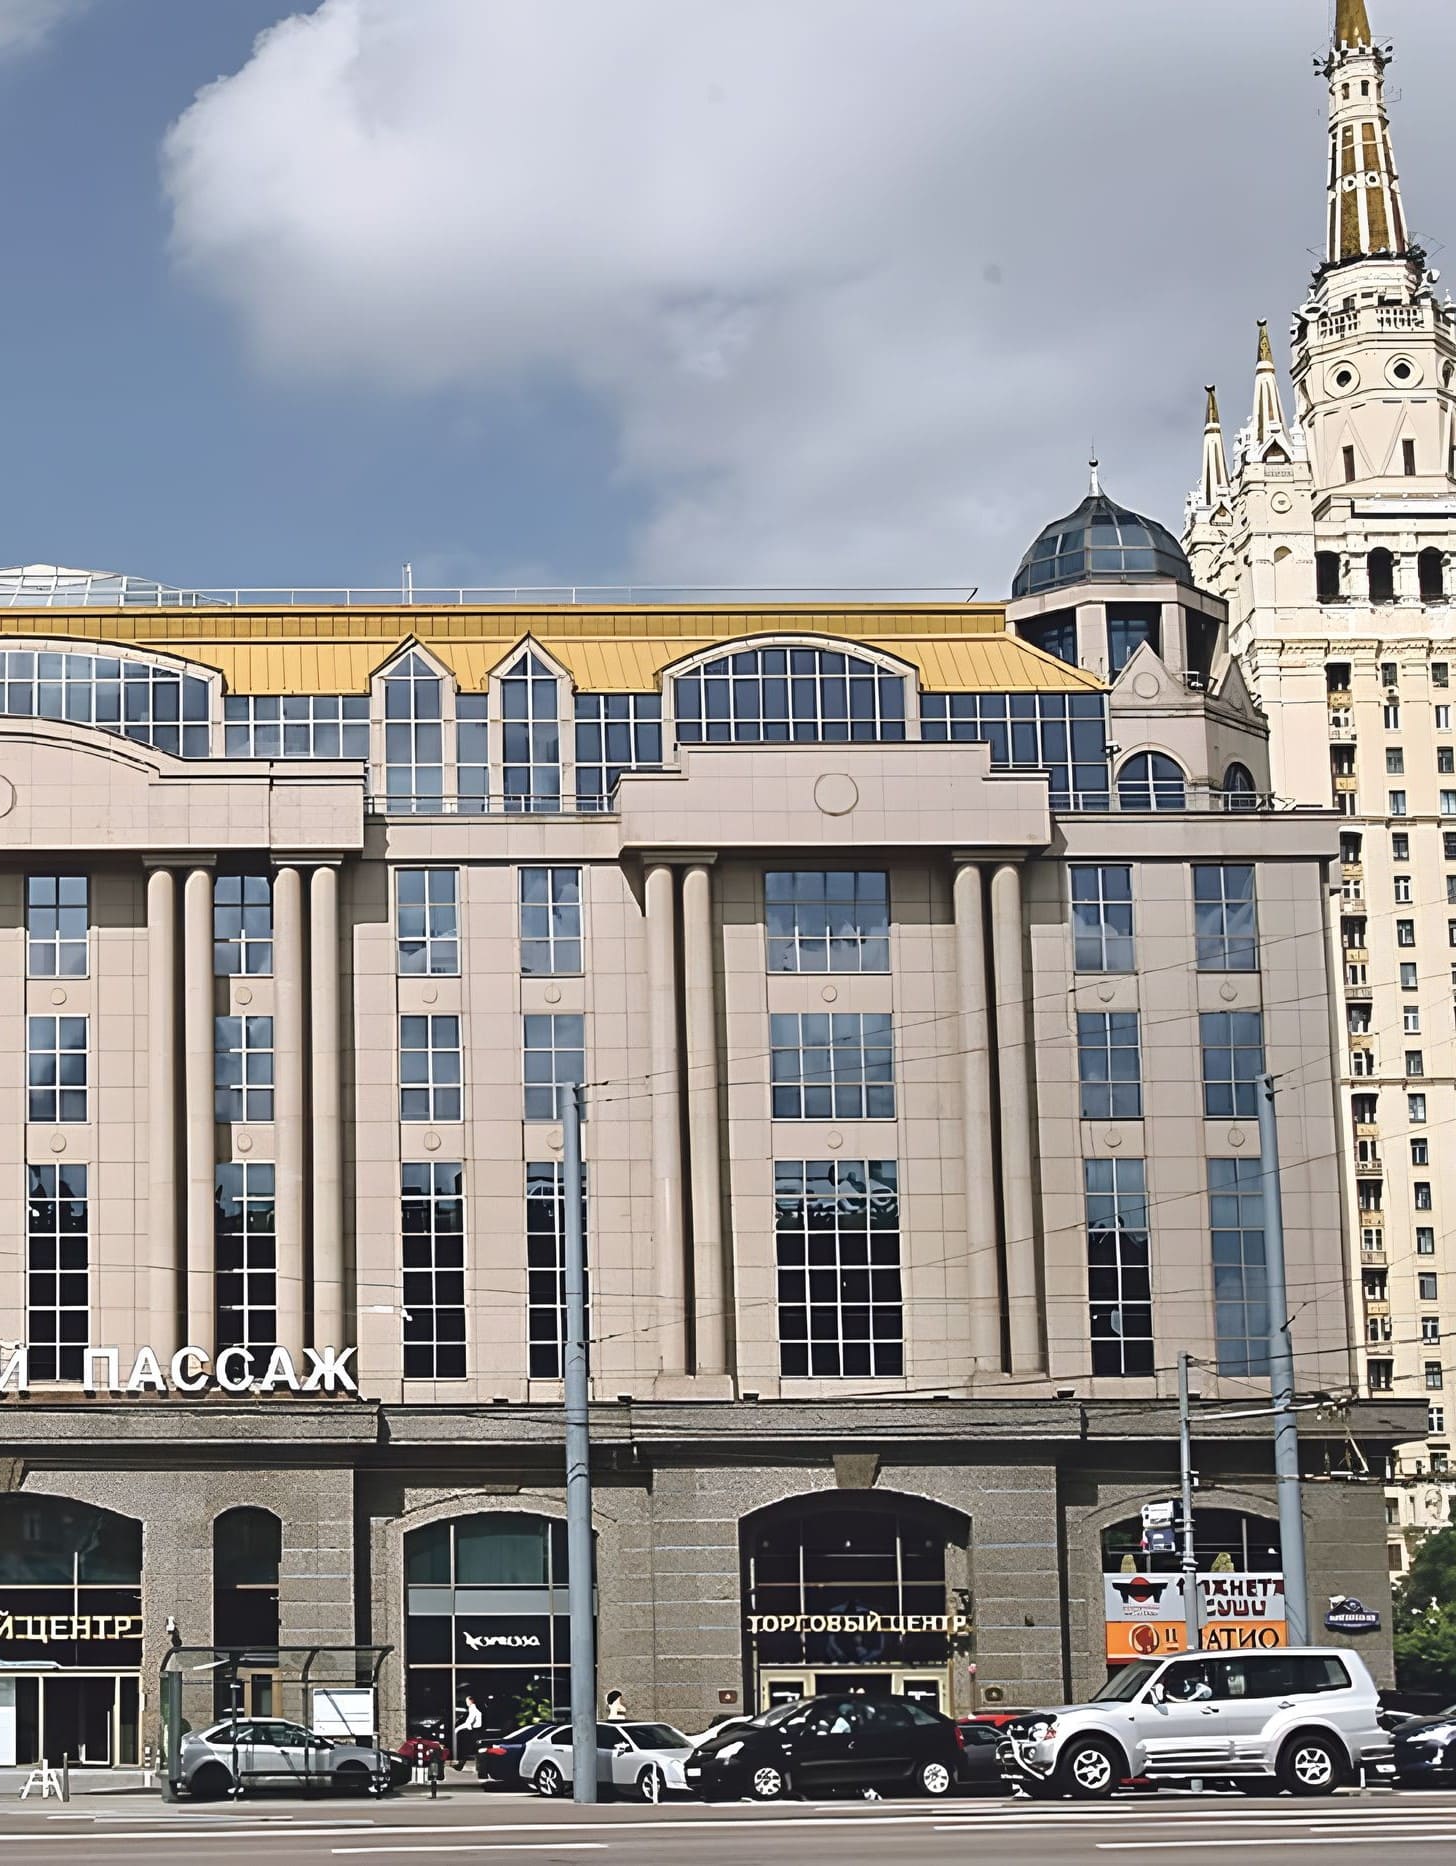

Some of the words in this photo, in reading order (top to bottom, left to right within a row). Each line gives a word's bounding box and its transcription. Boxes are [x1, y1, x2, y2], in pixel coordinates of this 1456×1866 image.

[82, 1345, 359, 1393] ПАССАЖ
[25, 1615, 133, 1644] ЦЕНТР
[746, 1610, 882, 1633] ТОРГОВЫЙ
[891, 1615, 967, 1635] ЦЕНТР
